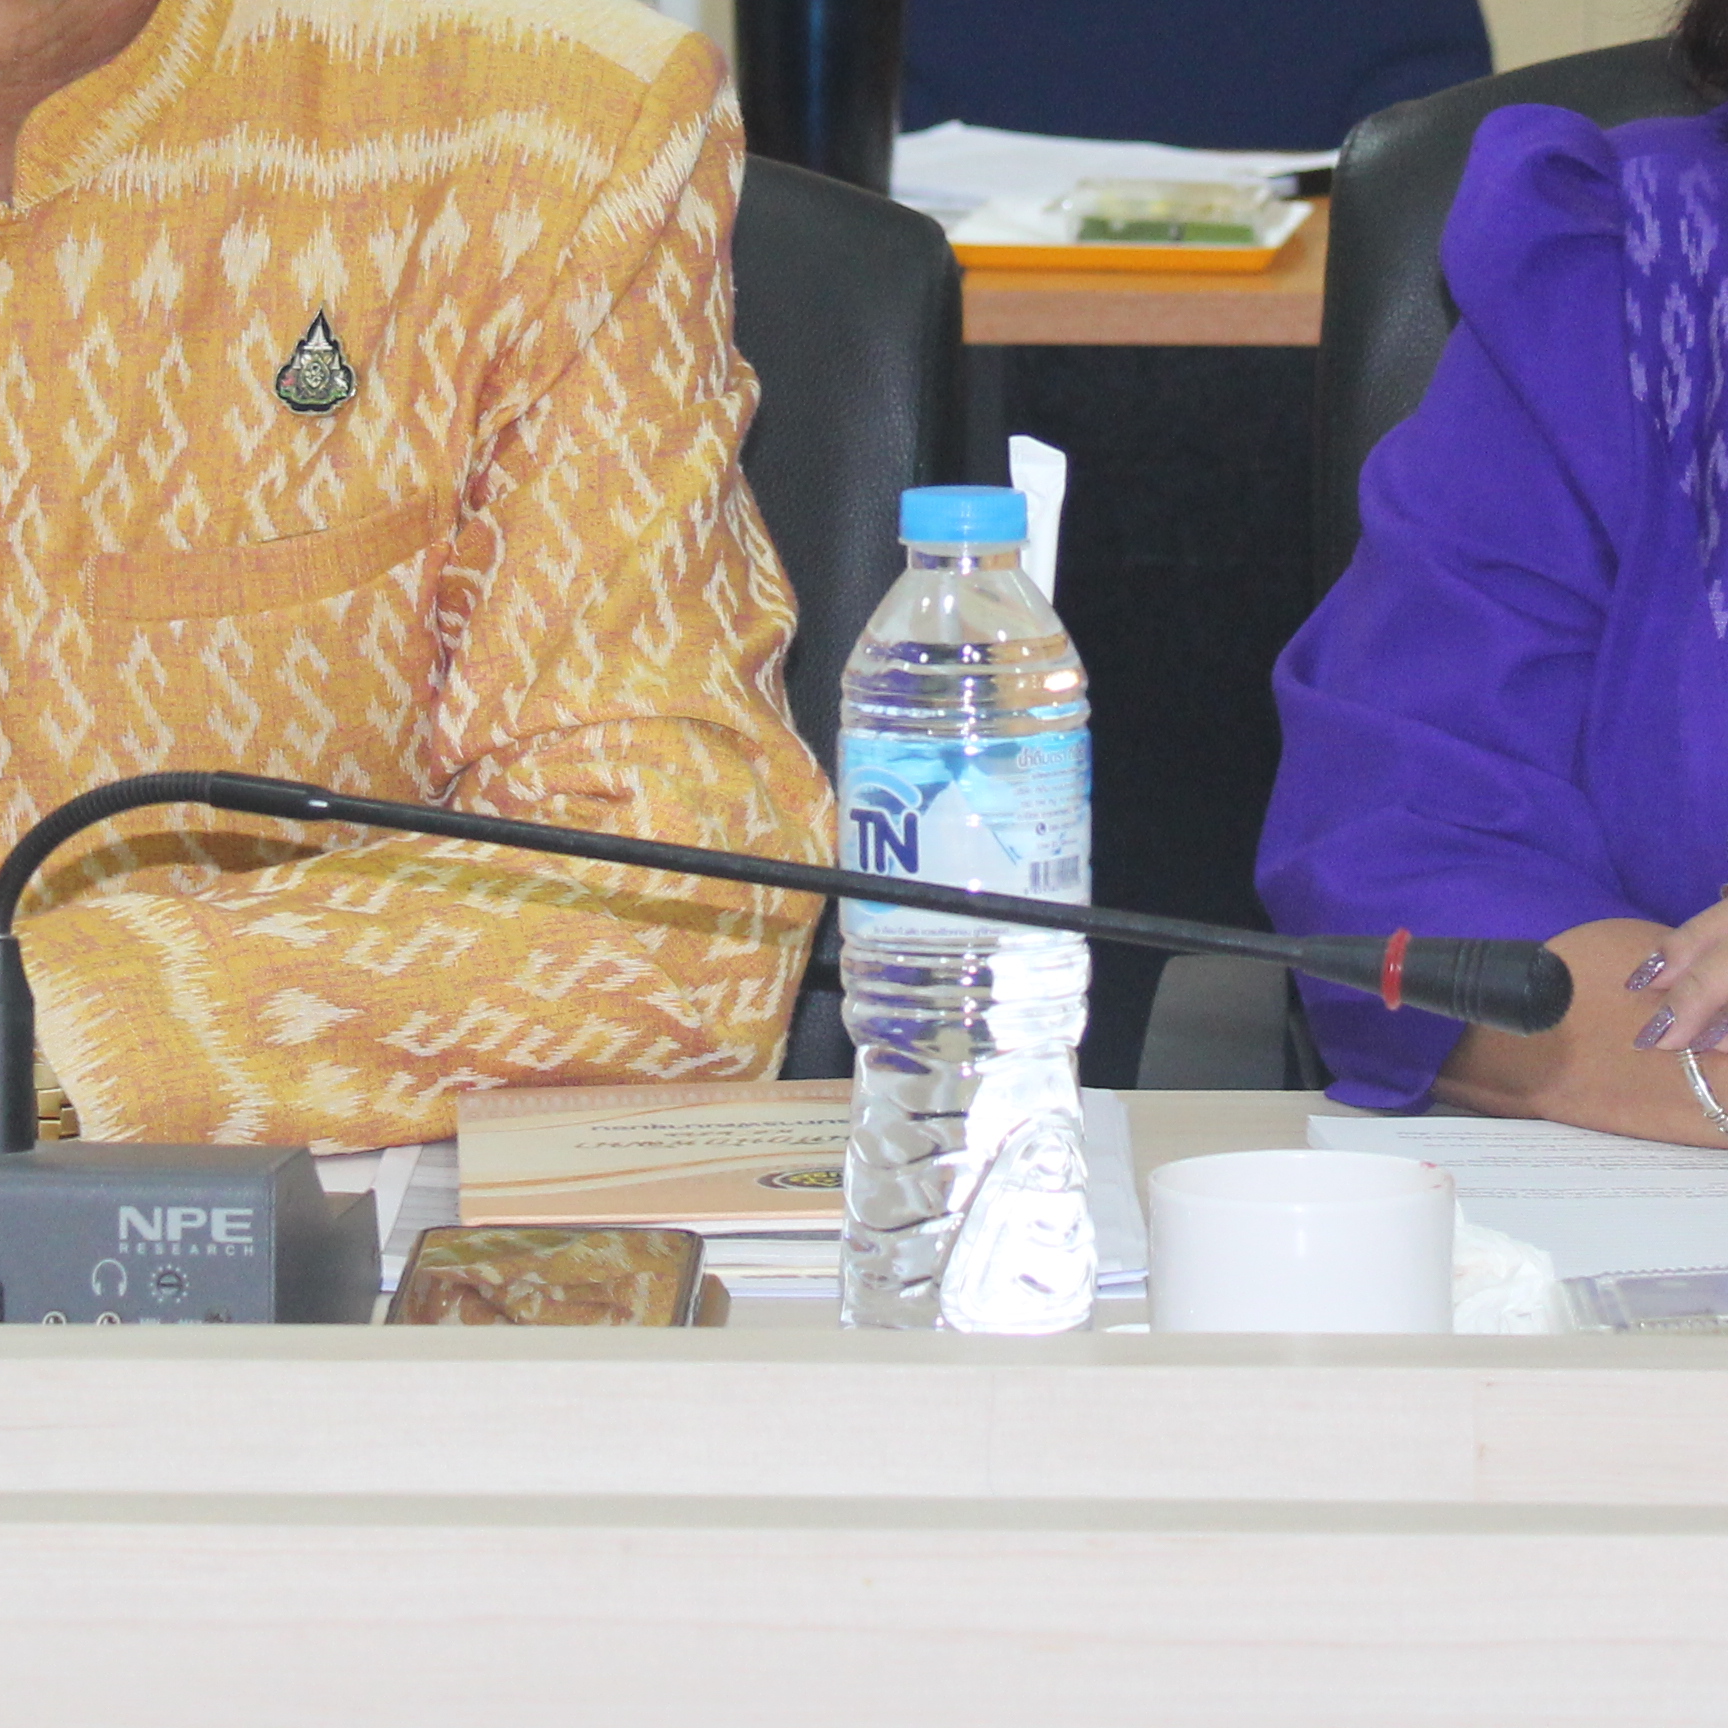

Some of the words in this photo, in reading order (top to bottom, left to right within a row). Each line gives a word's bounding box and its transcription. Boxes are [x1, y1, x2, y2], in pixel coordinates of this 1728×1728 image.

[850, 809, 919, 873] TN
[119, 1206, 254, 1243] NPE
[119, 1242, 255, 1256] RESEARCH
